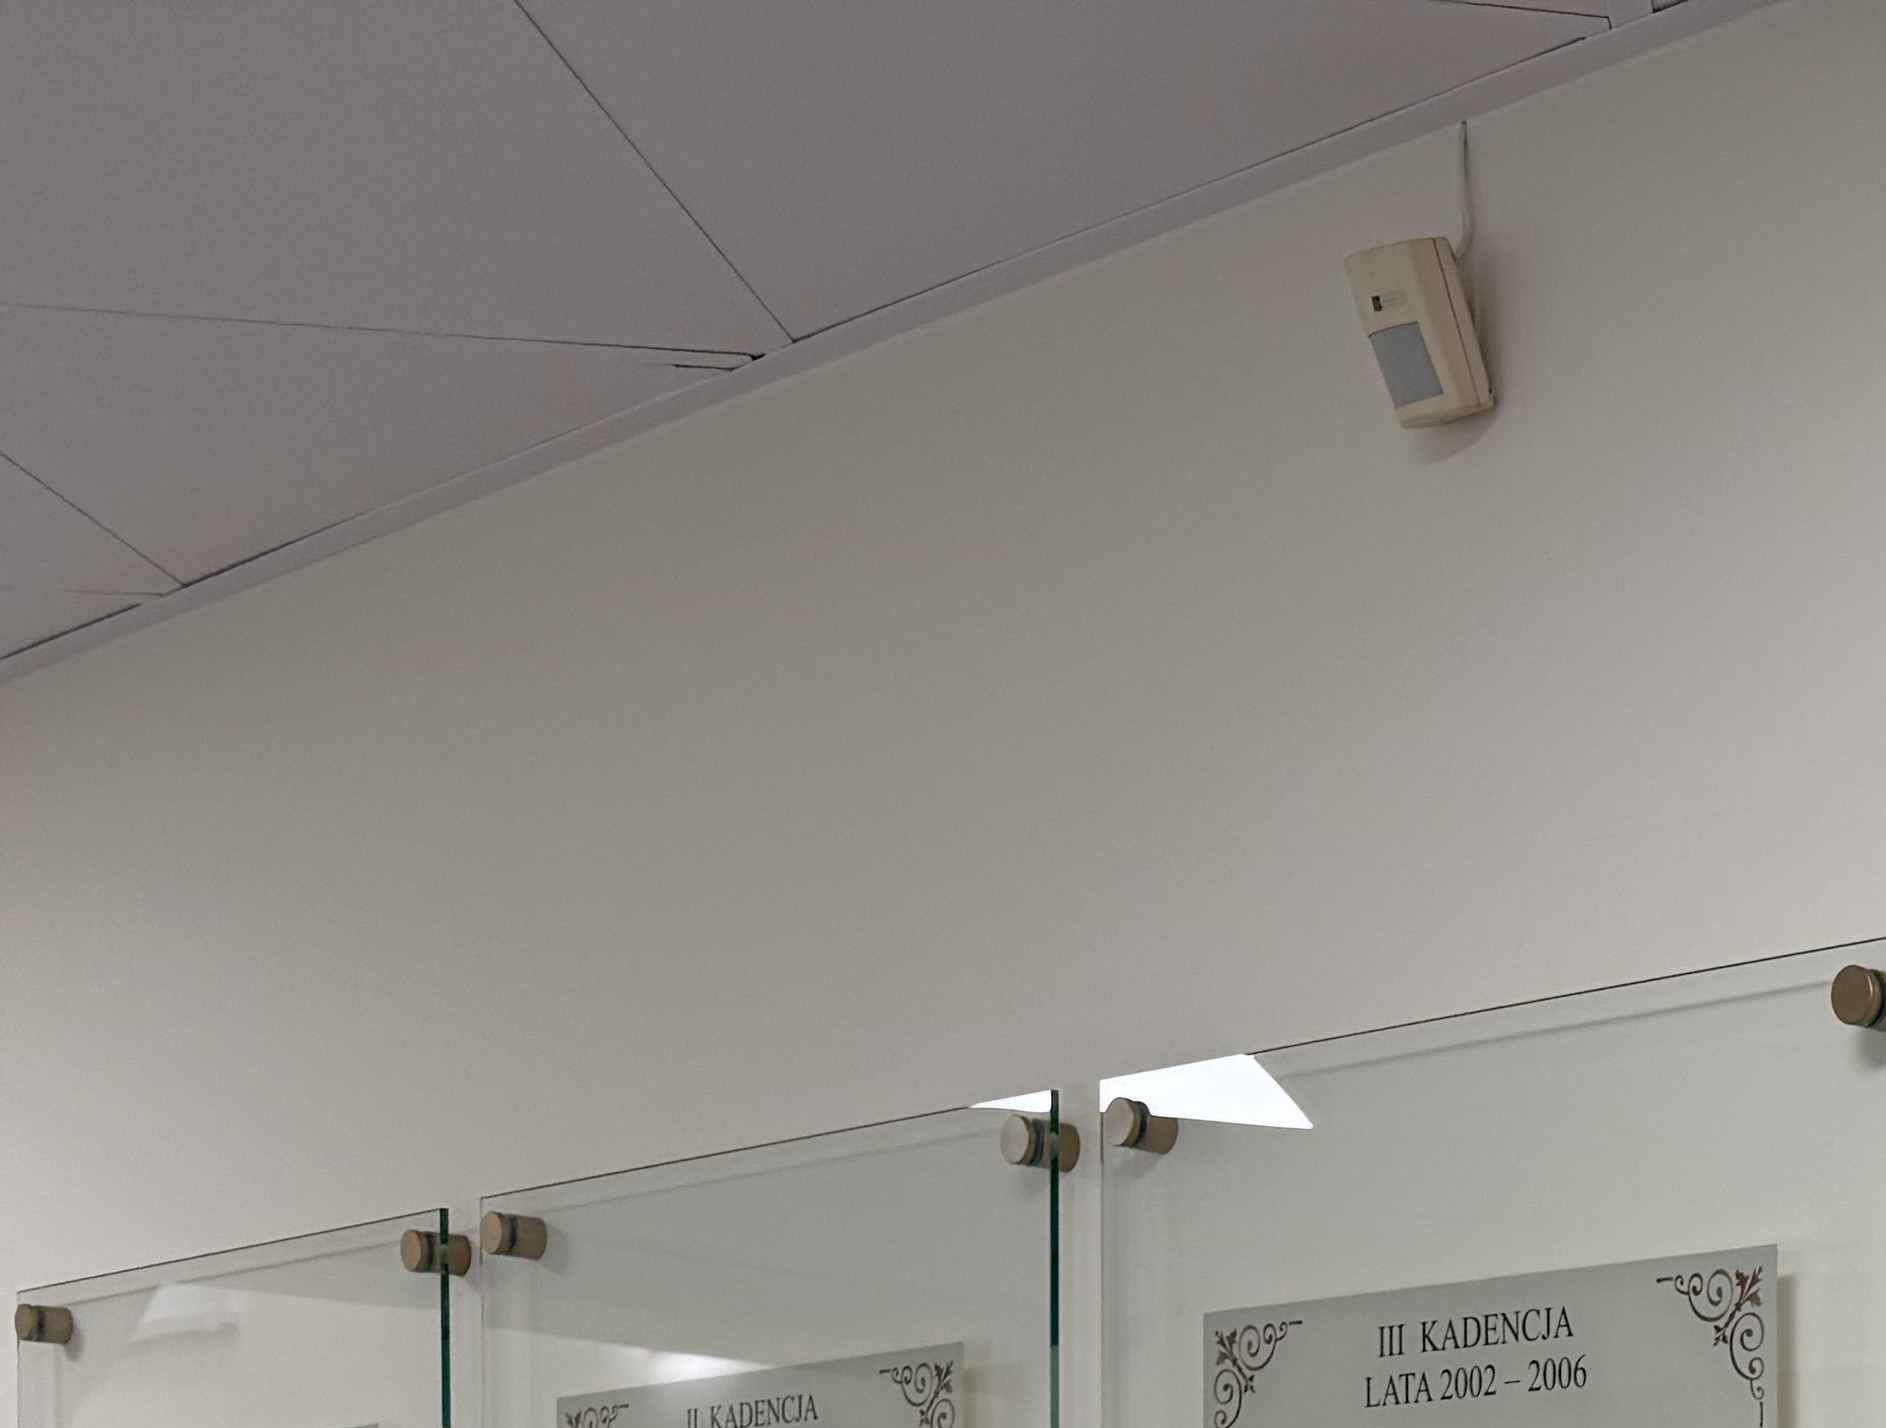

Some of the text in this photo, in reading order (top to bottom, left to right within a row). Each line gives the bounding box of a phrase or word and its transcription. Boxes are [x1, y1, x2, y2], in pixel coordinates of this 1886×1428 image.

[1378, 1306, 1574, 1358] III KADENCJA
[1365, 1372, 1433, 1408] LATA
[1440, 1364, 1497, 1400] 2002
[1528, 1354, 1587, 1392] 2006
